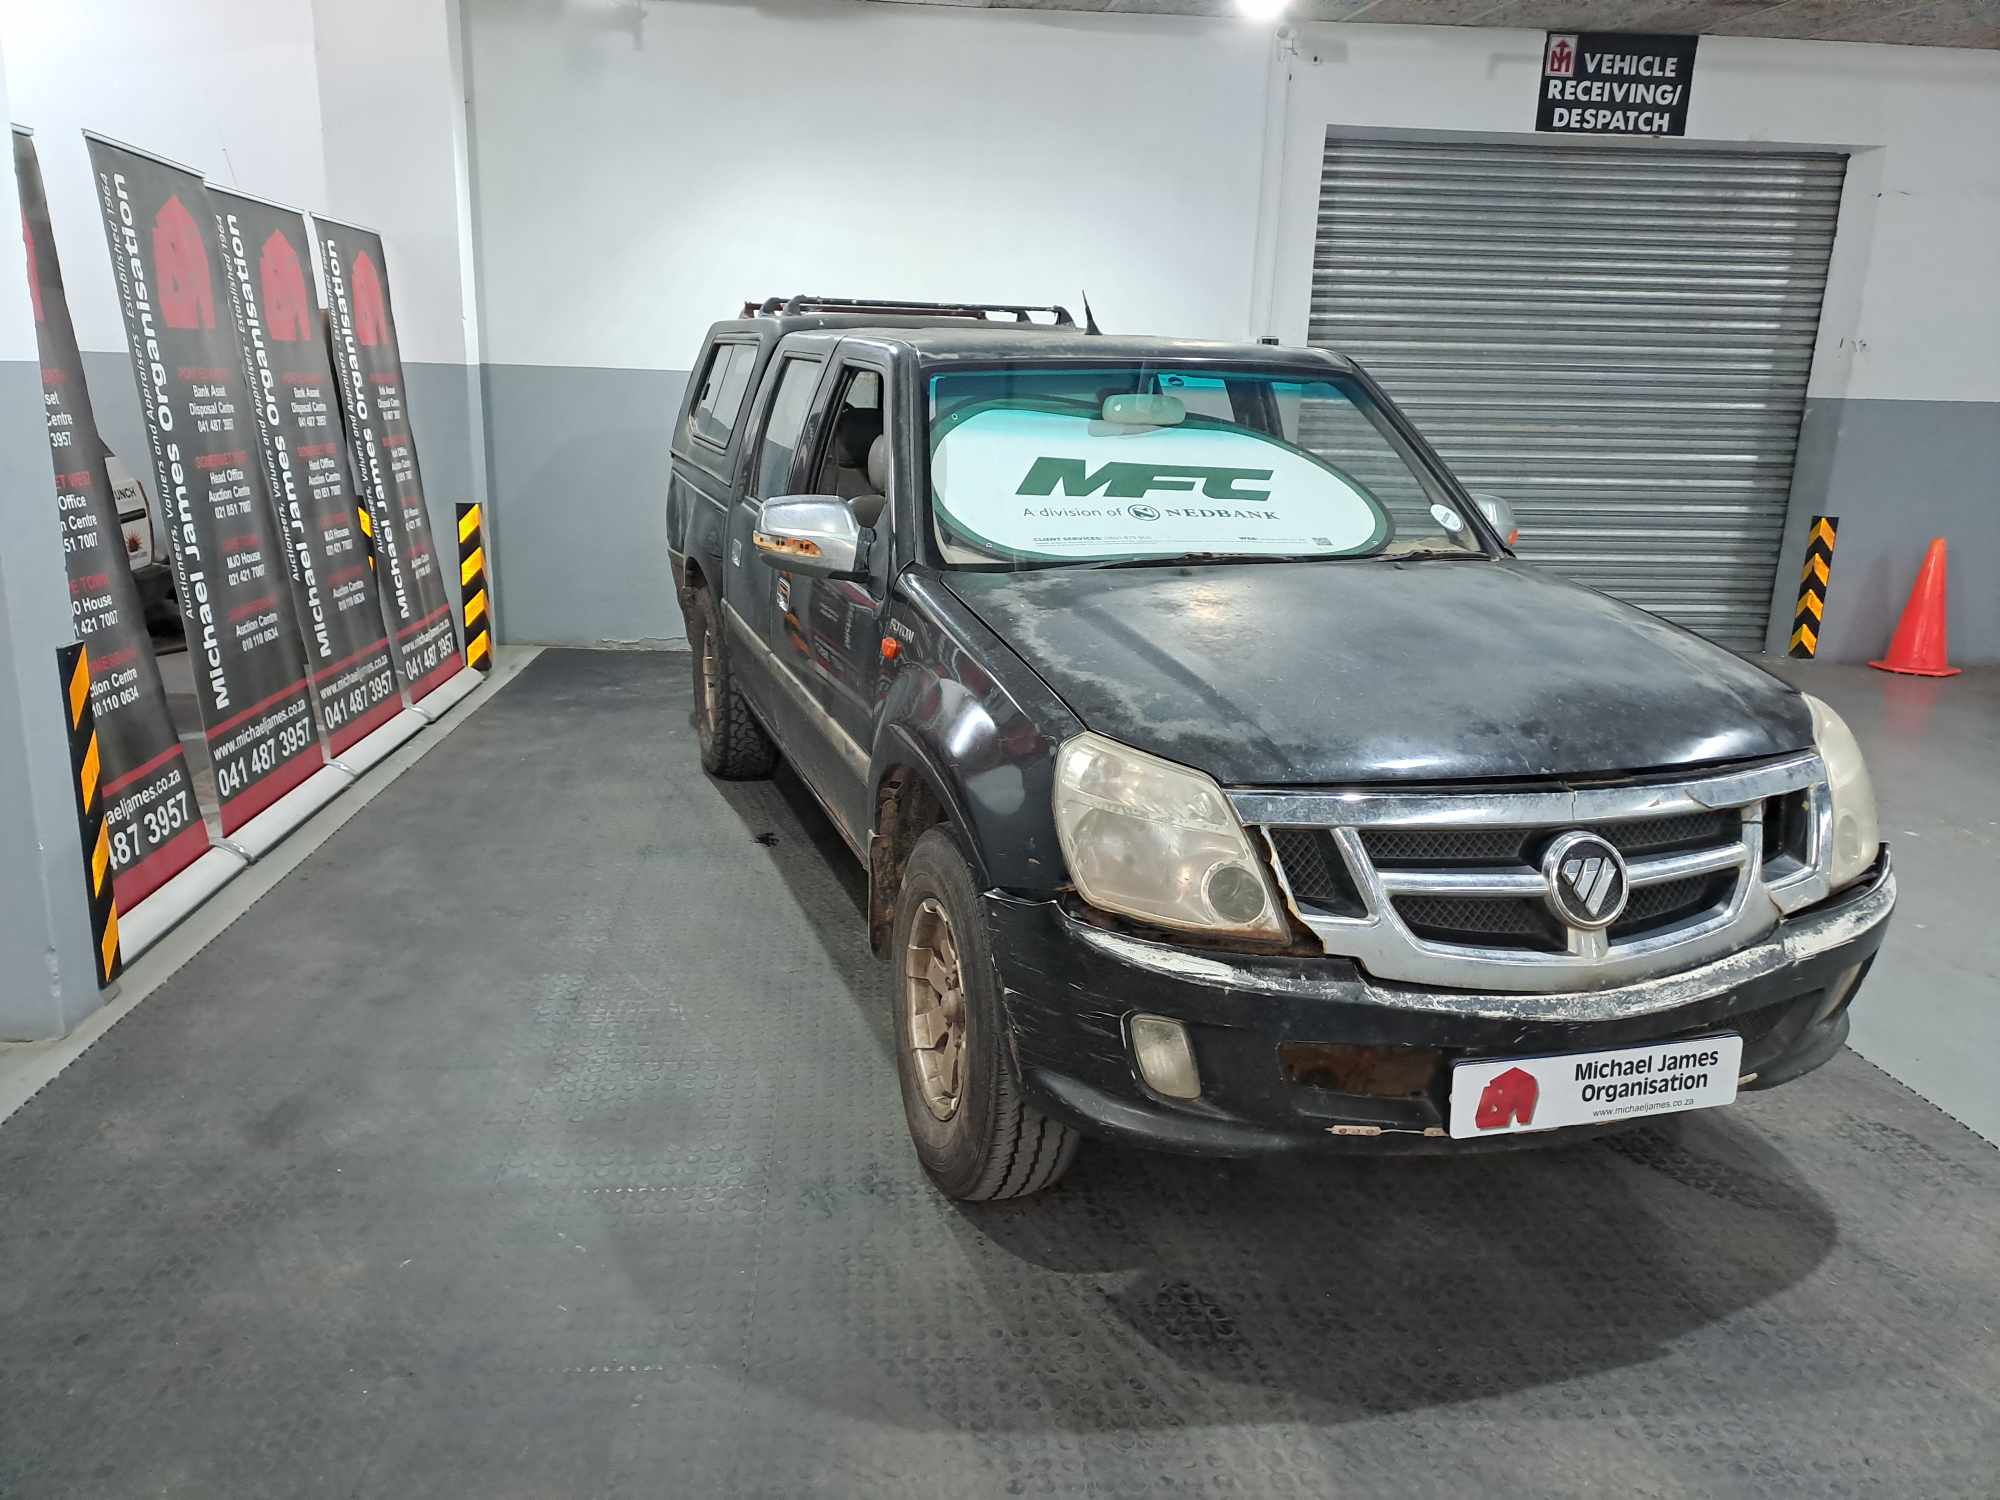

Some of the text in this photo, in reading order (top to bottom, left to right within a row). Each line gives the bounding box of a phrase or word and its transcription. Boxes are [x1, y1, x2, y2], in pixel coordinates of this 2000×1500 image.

[1584, 53, 1678, 77] VEHICLE
[1547, 79, 1683, 106] RECEIVING/
[1552, 107, 1670, 132] DESPATCH
[100, 172, 114, 215] 1964
[108, 220, 135, 319] Established
[223, 252, 246, 333] Established
[326, 239, 368, 420] Organisation
[132, 334, 155, 421] Appraisers
[244, 345, 265, 417] Appraisers
[51, 432, 72, 447] 3957
[113, 173, 230, 710] Michael James Organisation
[148, 424, 162, 456] and
[226, 214, 332, 658] Michael James Organisation
[257, 420, 270, 446] and
[351, 414, 360, 439] and
[157, 460, 174, 519] Valuers
[265, 449, 281, 498] Valuers
[362, 428, 388, 513] James
[1015, 456, 1274, 501] MFC
[58, 494, 87, 511] Office
[1023, 505, 1280, 521] A division of NEDBANK
[68, 514, 98, 530] Centre
[64, 532, 98, 553] 51 7007
[170, 524, 195, 620] Auctioneers,
[380, 519, 410, 620] Michael
[81, 616, 98, 634] 421
[99, 610, 119, 629] 7007
[82, 594, 113, 614] House
[405, 632, 454, 681] 041 487 3957
[111, 667, 138, 688] Centre
[102, 694, 119, 712] 110
[120, 685, 140, 706] 0634
[324, 670, 393, 729] 041 487 3957
[218, 716, 311, 797] 041 487 3957
[144, 790, 189, 844] 3957
[1574, 1049, 1719, 1083] Michael James
[1580, 1071, 1709, 1104] Organisation
[1592, 1097, 1695, 1119] www.michaeljames.co.za
